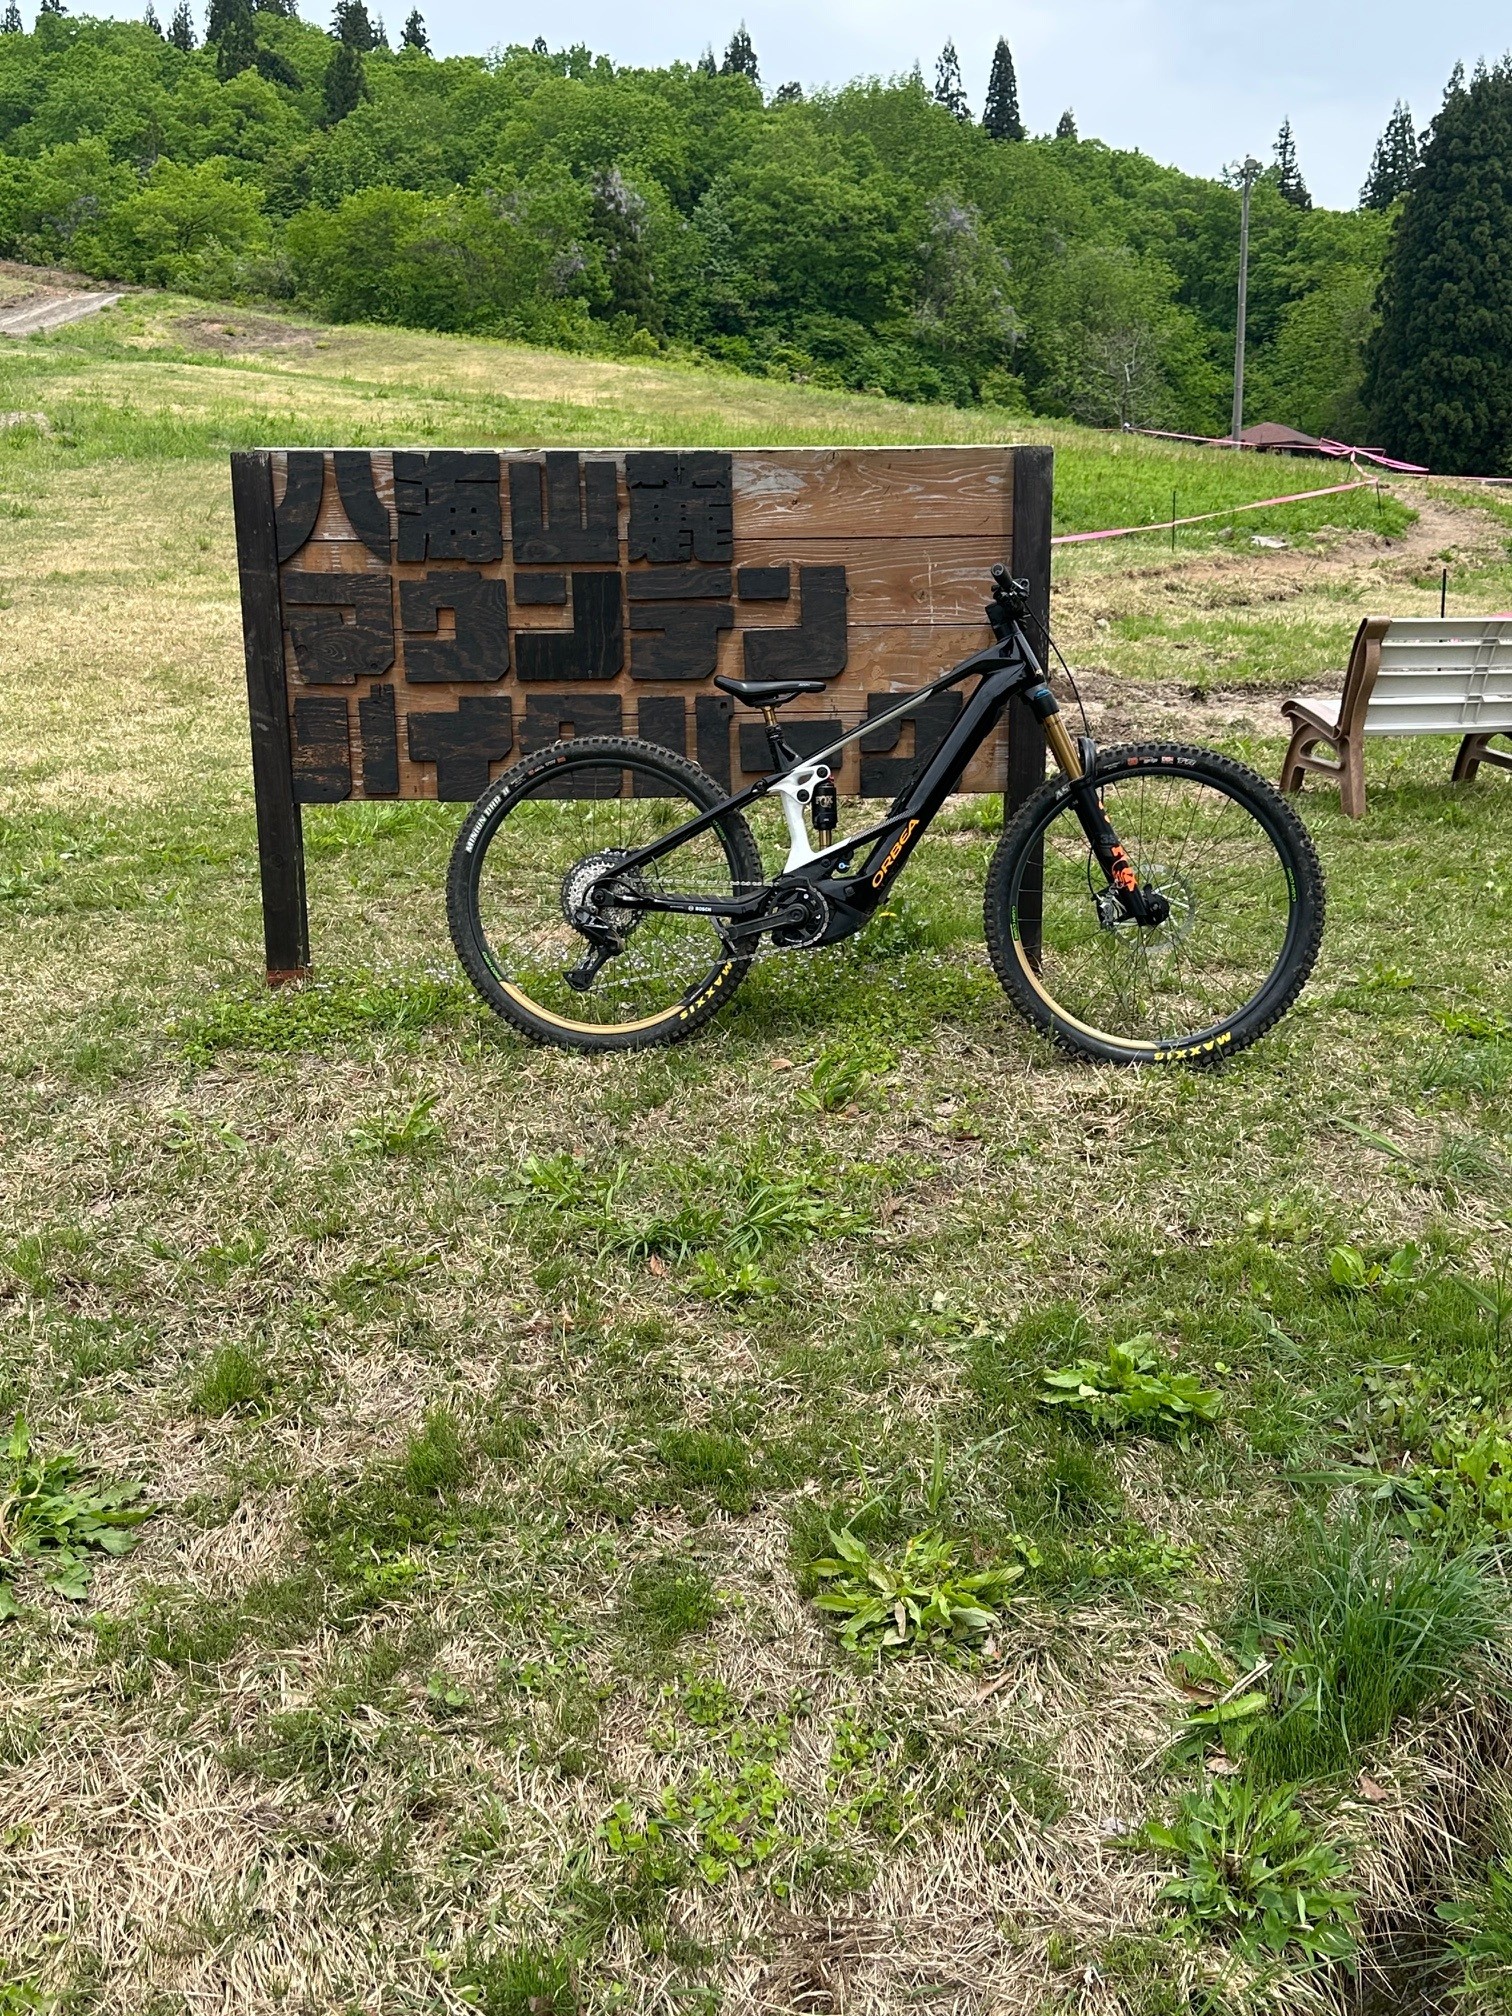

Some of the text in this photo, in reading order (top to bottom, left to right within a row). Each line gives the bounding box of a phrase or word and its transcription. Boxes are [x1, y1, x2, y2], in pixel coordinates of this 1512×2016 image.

[277, 451, 733, 565] 八海山麓
[283, 566, 848, 685] マウンテン
[815, 795, 834, 809] FOX
[465, 813, 487, 854] MINION
[872, 819, 920, 888] ORBEA
[679, 960, 733, 1020] MAXXIS
[1153, 1031, 1232, 1061] MAXXIS
